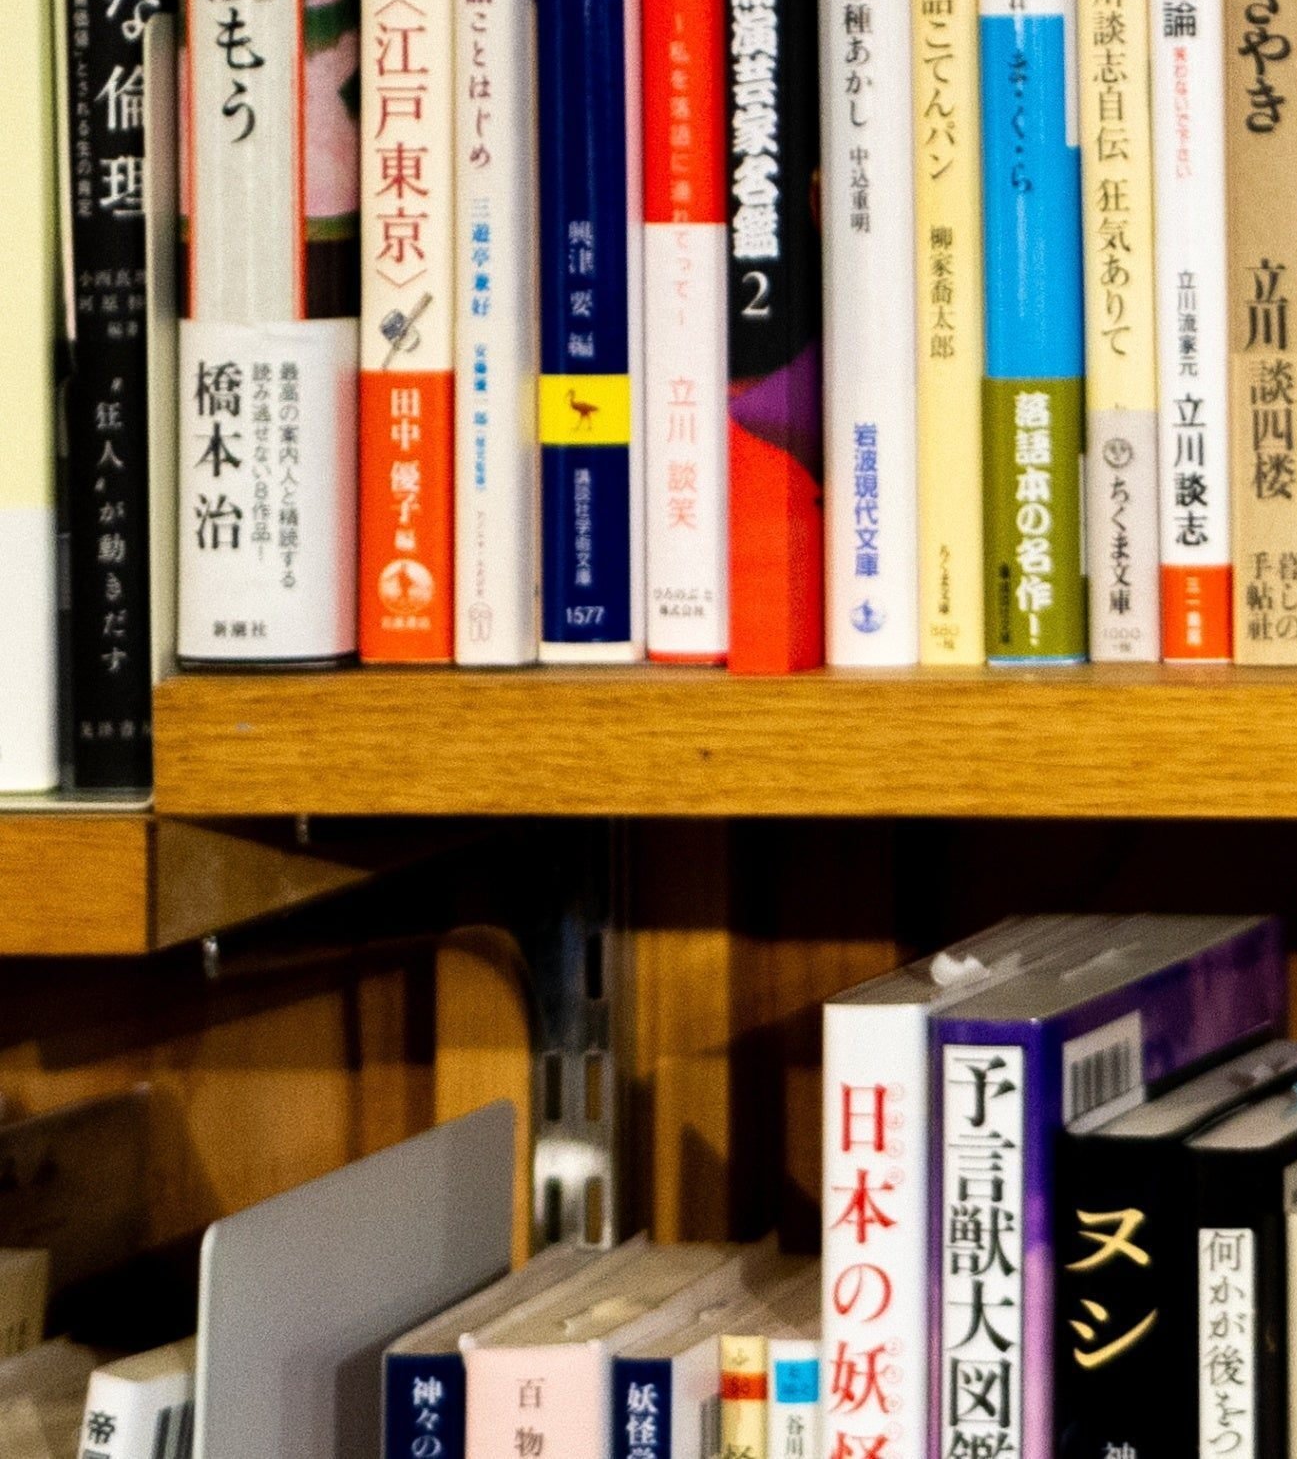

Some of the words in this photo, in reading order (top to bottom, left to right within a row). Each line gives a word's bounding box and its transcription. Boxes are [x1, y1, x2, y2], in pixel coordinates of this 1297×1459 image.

[848, 147, 871, 234] 中込重明
[741, 271, 772, 317] 2
[927, 224, 956, 360] 柳家喬太郎
[1097, 177, 1133, 357] 狂気ありて
[1176, 269, 1199, 377] 立川流家元
[1244, 257, 1294, 503] 立川談四楼
[192, 358, 243, 552] 橋本治
[667, 375, 700, 531] 立川談笑
[852, 422, 880, 578] 岩波現代文庫
[1172, 391, 1209, 548] 立川談志
[565, 605, 605, 625] 1577
[1108, 475, 1132, 617] ちくま文庫
[1247, 551, 1274, 643] 手帖社
[212, 620, 268, 639] 新潮社
[1064, 1206, 1160, 1371] ヌシ
[1204, 1229, 1247, 1455] 何かが後をつ
[411, 1375, 444, 1459] 神々の
[513, 1376, 546, 1459] 百物
